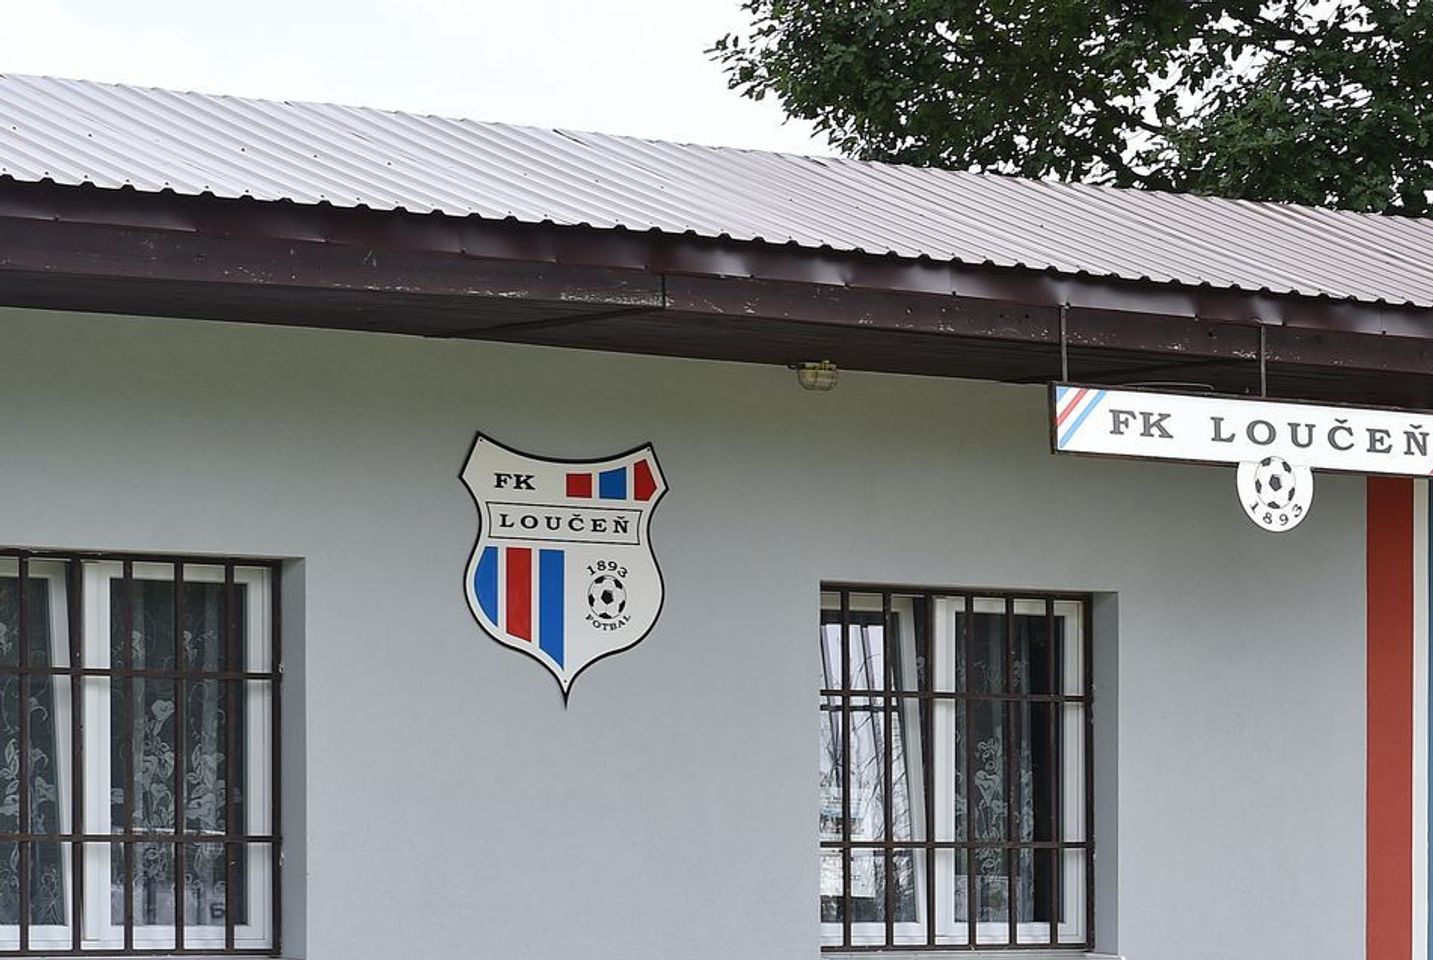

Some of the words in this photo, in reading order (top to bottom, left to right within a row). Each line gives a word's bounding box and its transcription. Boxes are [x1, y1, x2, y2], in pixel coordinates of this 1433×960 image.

[1109, 409, 1174, 438] FK
[1210, 417, 1430, 457] LOUČEŇ
[494, 473, 536, 490] FK
[499, 513, 630, 534] LOUČEŇ
[1249, 502, 1303, 526] 1893
[586, 560, 628, 578] 1893
[585, 613, 632, 631] FOTBAL
